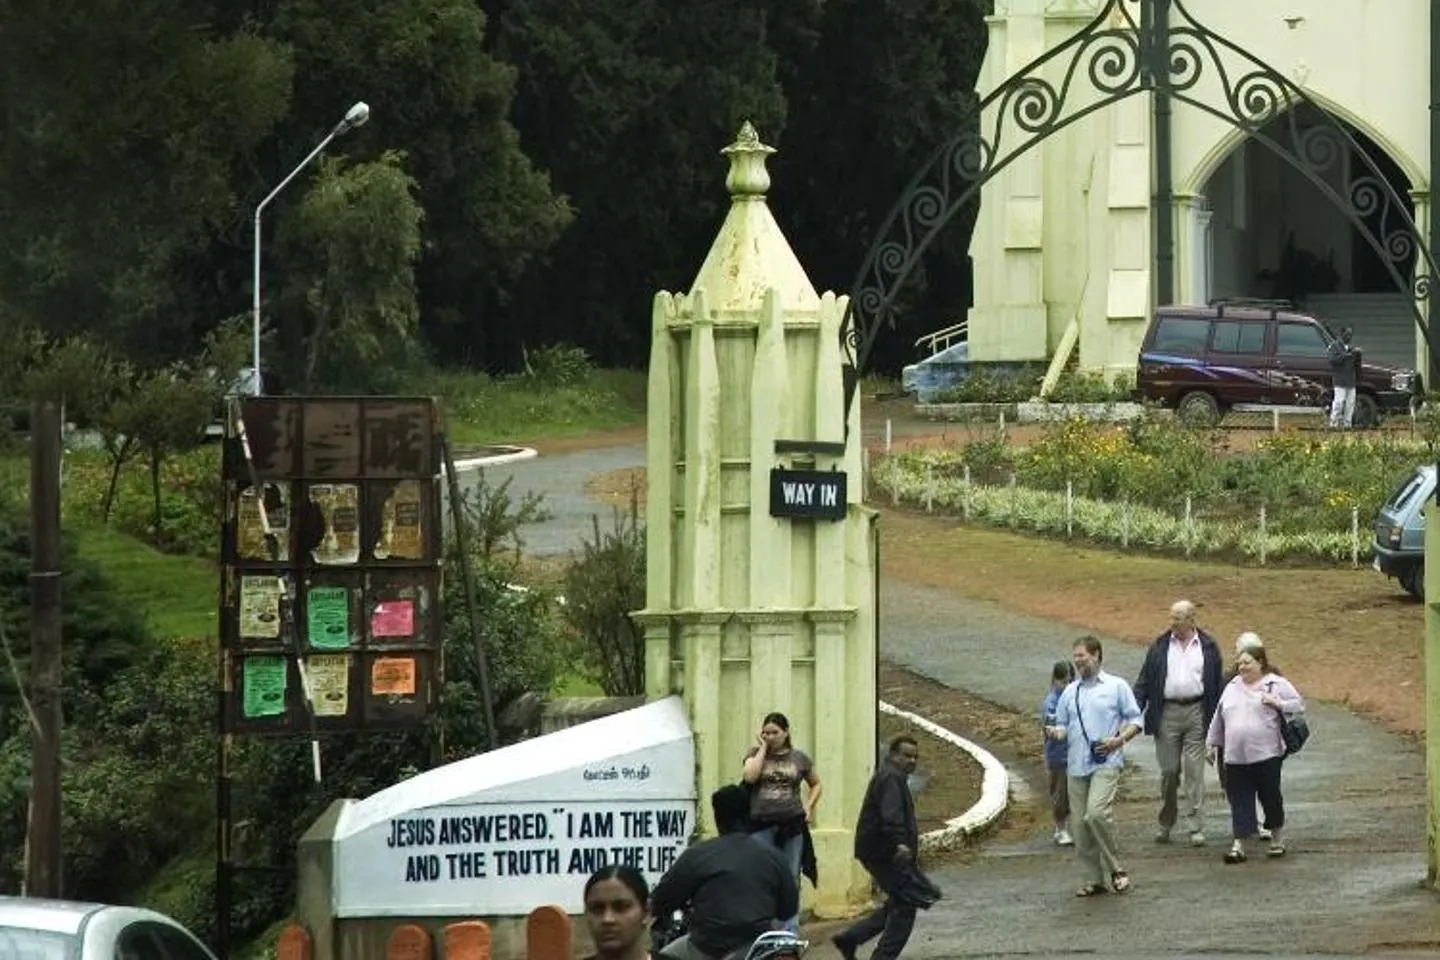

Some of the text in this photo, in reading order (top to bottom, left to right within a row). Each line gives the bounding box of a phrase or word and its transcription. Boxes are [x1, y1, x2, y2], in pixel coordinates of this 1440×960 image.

[782, 481, 837, 506] WAY IN
[387, 818, 435, 848] JESUS
[579, 812, 614, 839] AM
[620, 811, 651, 838] THE
[655, 809, 688, 838] WAY
[405, 854, 440, 882] AND
[445, 852, 486, 879] THE
[493, 848, 560, 877] TRUTH
[567, 847, 608, 874] AND
[610, 845, 644, 872] THE
